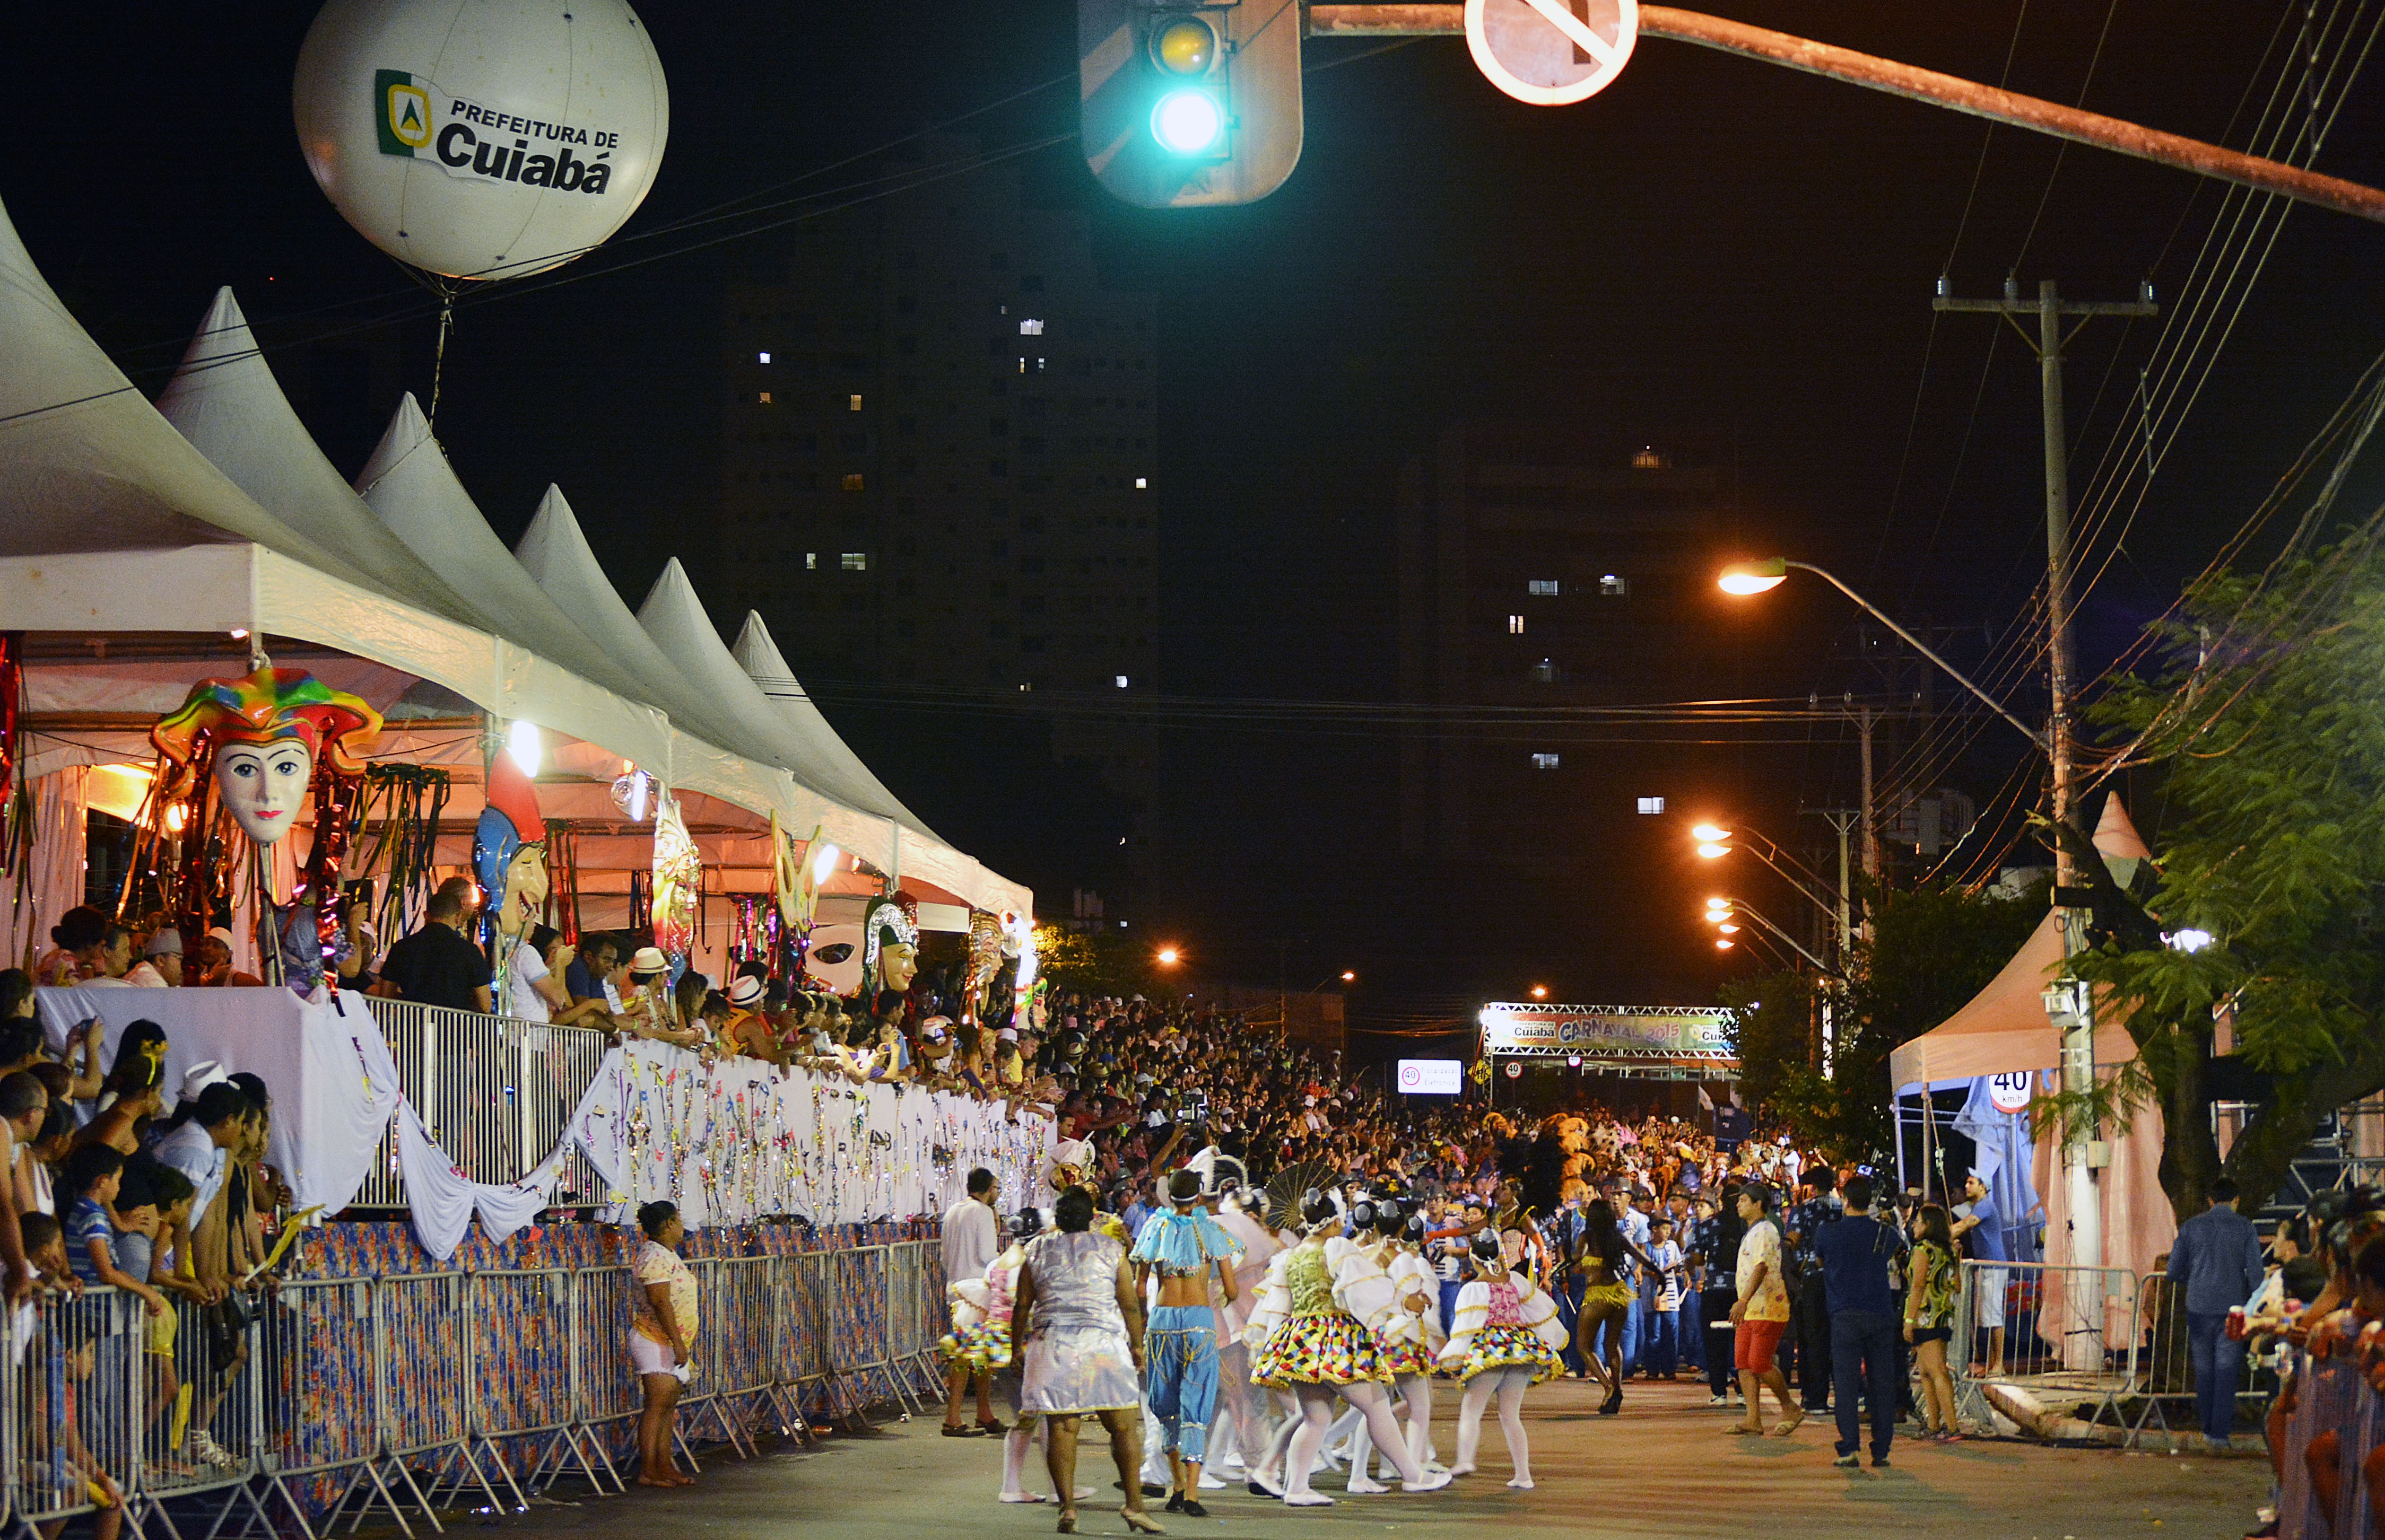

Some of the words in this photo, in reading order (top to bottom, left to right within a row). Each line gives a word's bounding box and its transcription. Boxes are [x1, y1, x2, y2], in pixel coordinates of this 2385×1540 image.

[451, 100, 588, 145] PREFEITURA
[594, 131, 619, 149] DE
[436, 122, 611, 195] Cuiabá
[1514, 1026, 1555, 1037] Cuiabá
[1559, 1018, 1640, 1043] CARNAVAL
[1646, 1023, 1681, 1042] 2015
[1508, 1064, 1518, 1072] 40
[1994, 1071, 2027, 1091] 40
